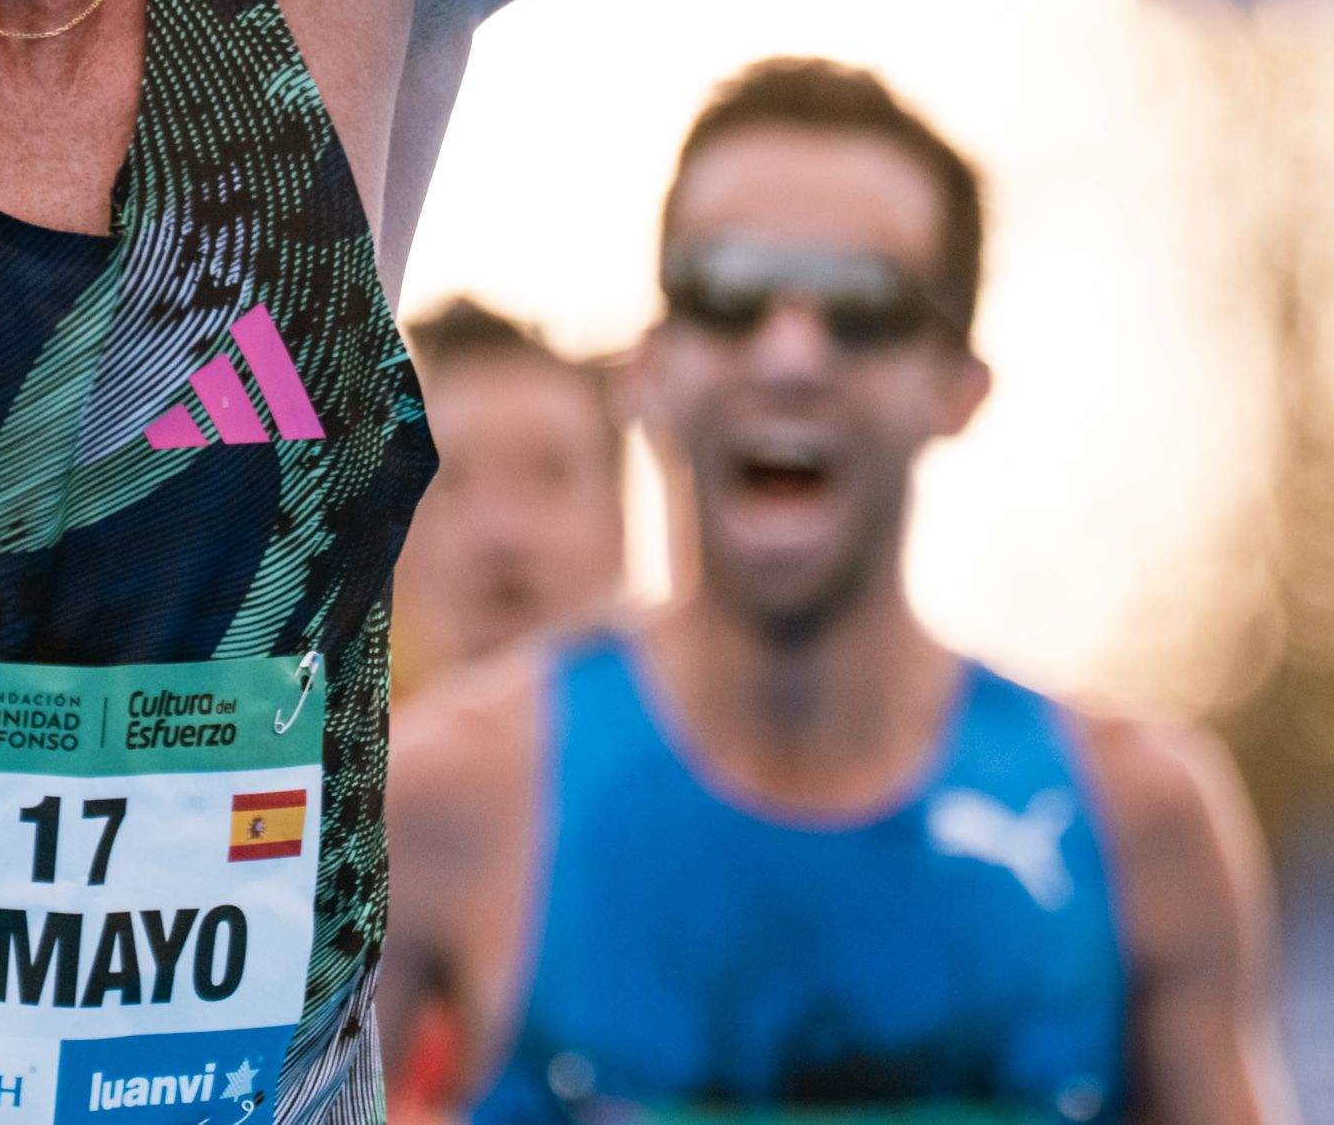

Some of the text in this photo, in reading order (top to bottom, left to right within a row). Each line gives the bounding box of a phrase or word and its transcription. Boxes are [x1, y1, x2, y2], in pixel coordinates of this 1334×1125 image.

[128, 690, 237, 718] Cultura del
[125, 719, 237, 750] Esfuerzo
[20, 795, 127, 886] 17
[89, 1063, 216, 1111] luanvi
